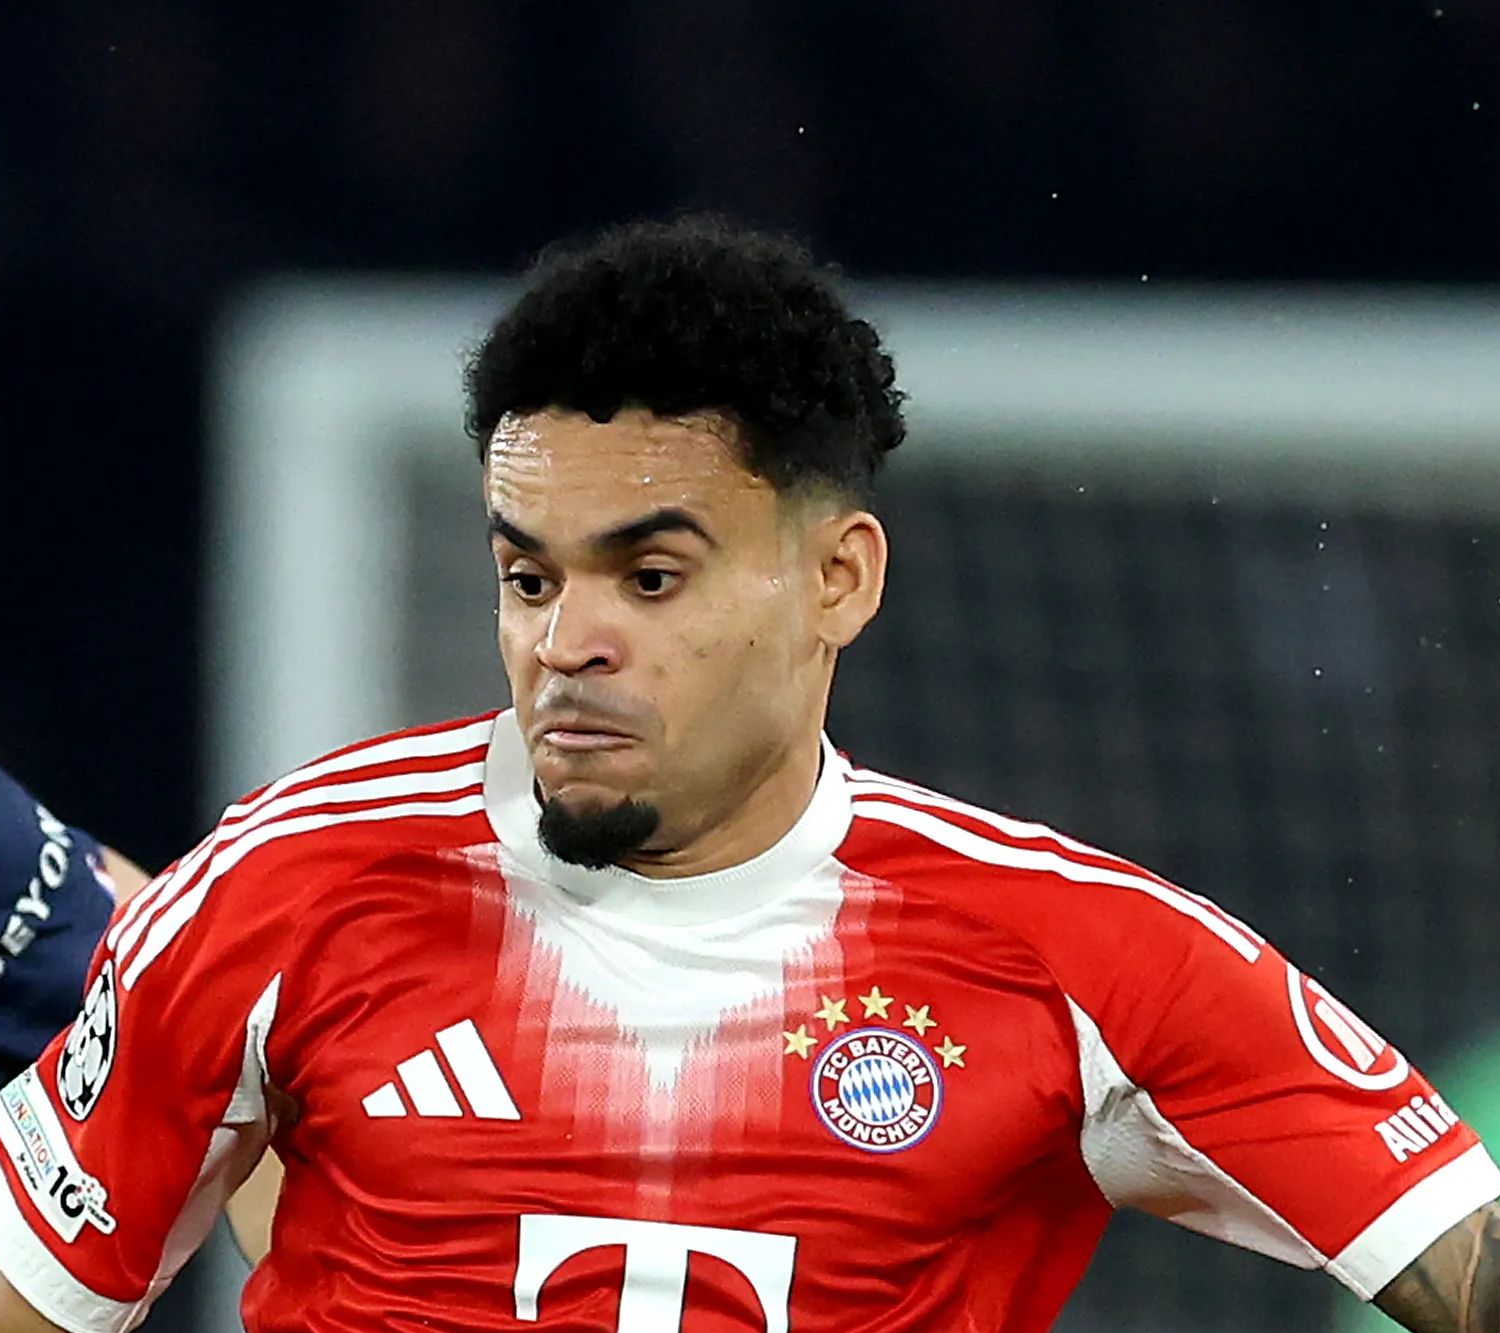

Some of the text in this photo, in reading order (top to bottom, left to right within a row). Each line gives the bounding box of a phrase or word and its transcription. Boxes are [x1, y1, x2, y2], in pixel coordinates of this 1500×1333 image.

[822, 1037, 931, 1086] FC BAYERN
[49, 1165, 86, 1219] 10
